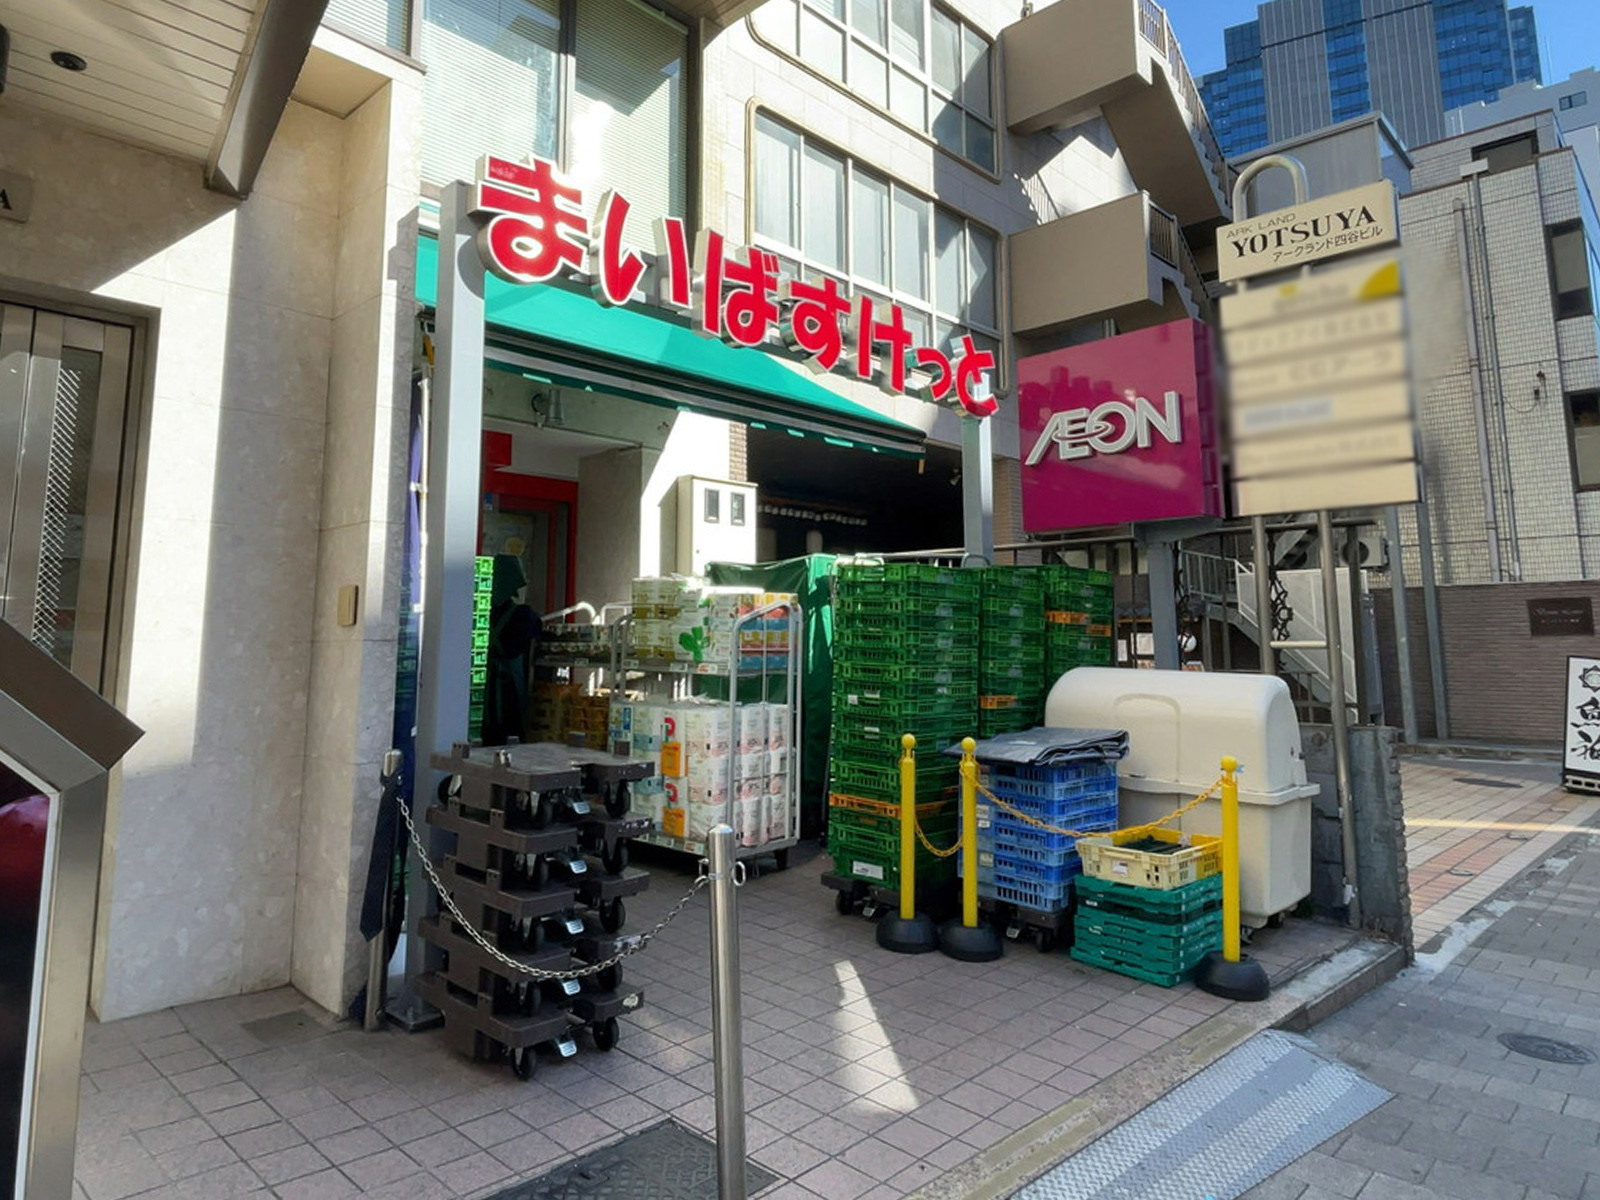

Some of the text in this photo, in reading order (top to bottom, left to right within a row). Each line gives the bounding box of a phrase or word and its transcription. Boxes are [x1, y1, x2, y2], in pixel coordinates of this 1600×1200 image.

[1226, 213, 1296, 240] ARK LAND
[1232, 205, 1376, 258] YOTSUYA
[1273, 225, 1384, 263] アークランド四谷ビル
[477, 153, 999, 418] まいばすけっと
